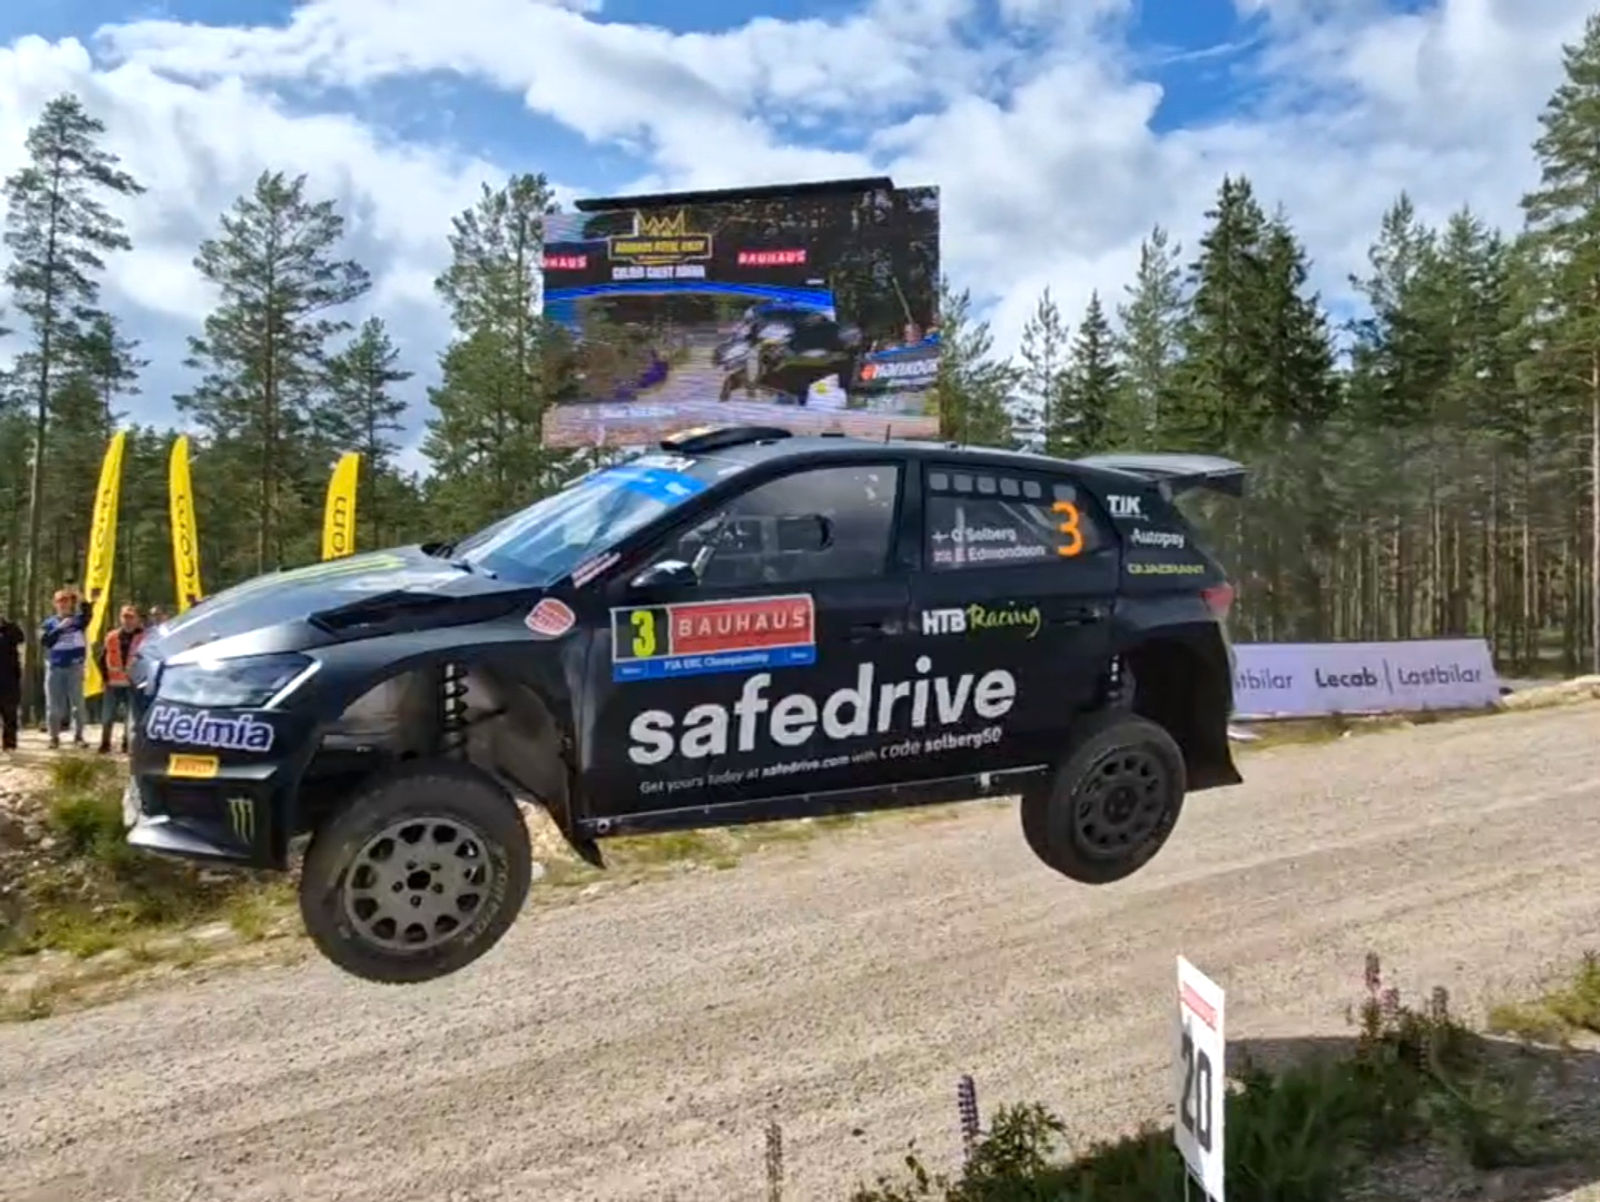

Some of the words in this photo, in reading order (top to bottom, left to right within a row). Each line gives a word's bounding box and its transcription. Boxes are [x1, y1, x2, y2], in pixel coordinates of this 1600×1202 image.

[738, 249, 807, 265] BAUHAUS
[966, 527, 1016, 542] Solberg
[1050, 500, 1084, 556] 3
[1130, 528, 1185, 549] Autopay
[631, 610, 656, 657] 3
[677, 608, 806, 638] BAUHAUS
[966, 601, 1041, 639] Racing
[1315, 666, 1378, 688] Lecab
[1398, 663, 1481, 685] Lastbilar
[146, 706, 274, 751] Helmia
[628, 655, 1017, 765] safedrive
[640, 780, 664, 794] Get
[666, 777, 704, 793] yours
[708, 769, 745, 786] today
[762, 755, 850, 778] safedrive.com
[851, 750, 877, 763] with
[880, 739, 921, 759] code
[1181, 1029, 1212, 1154] 20
